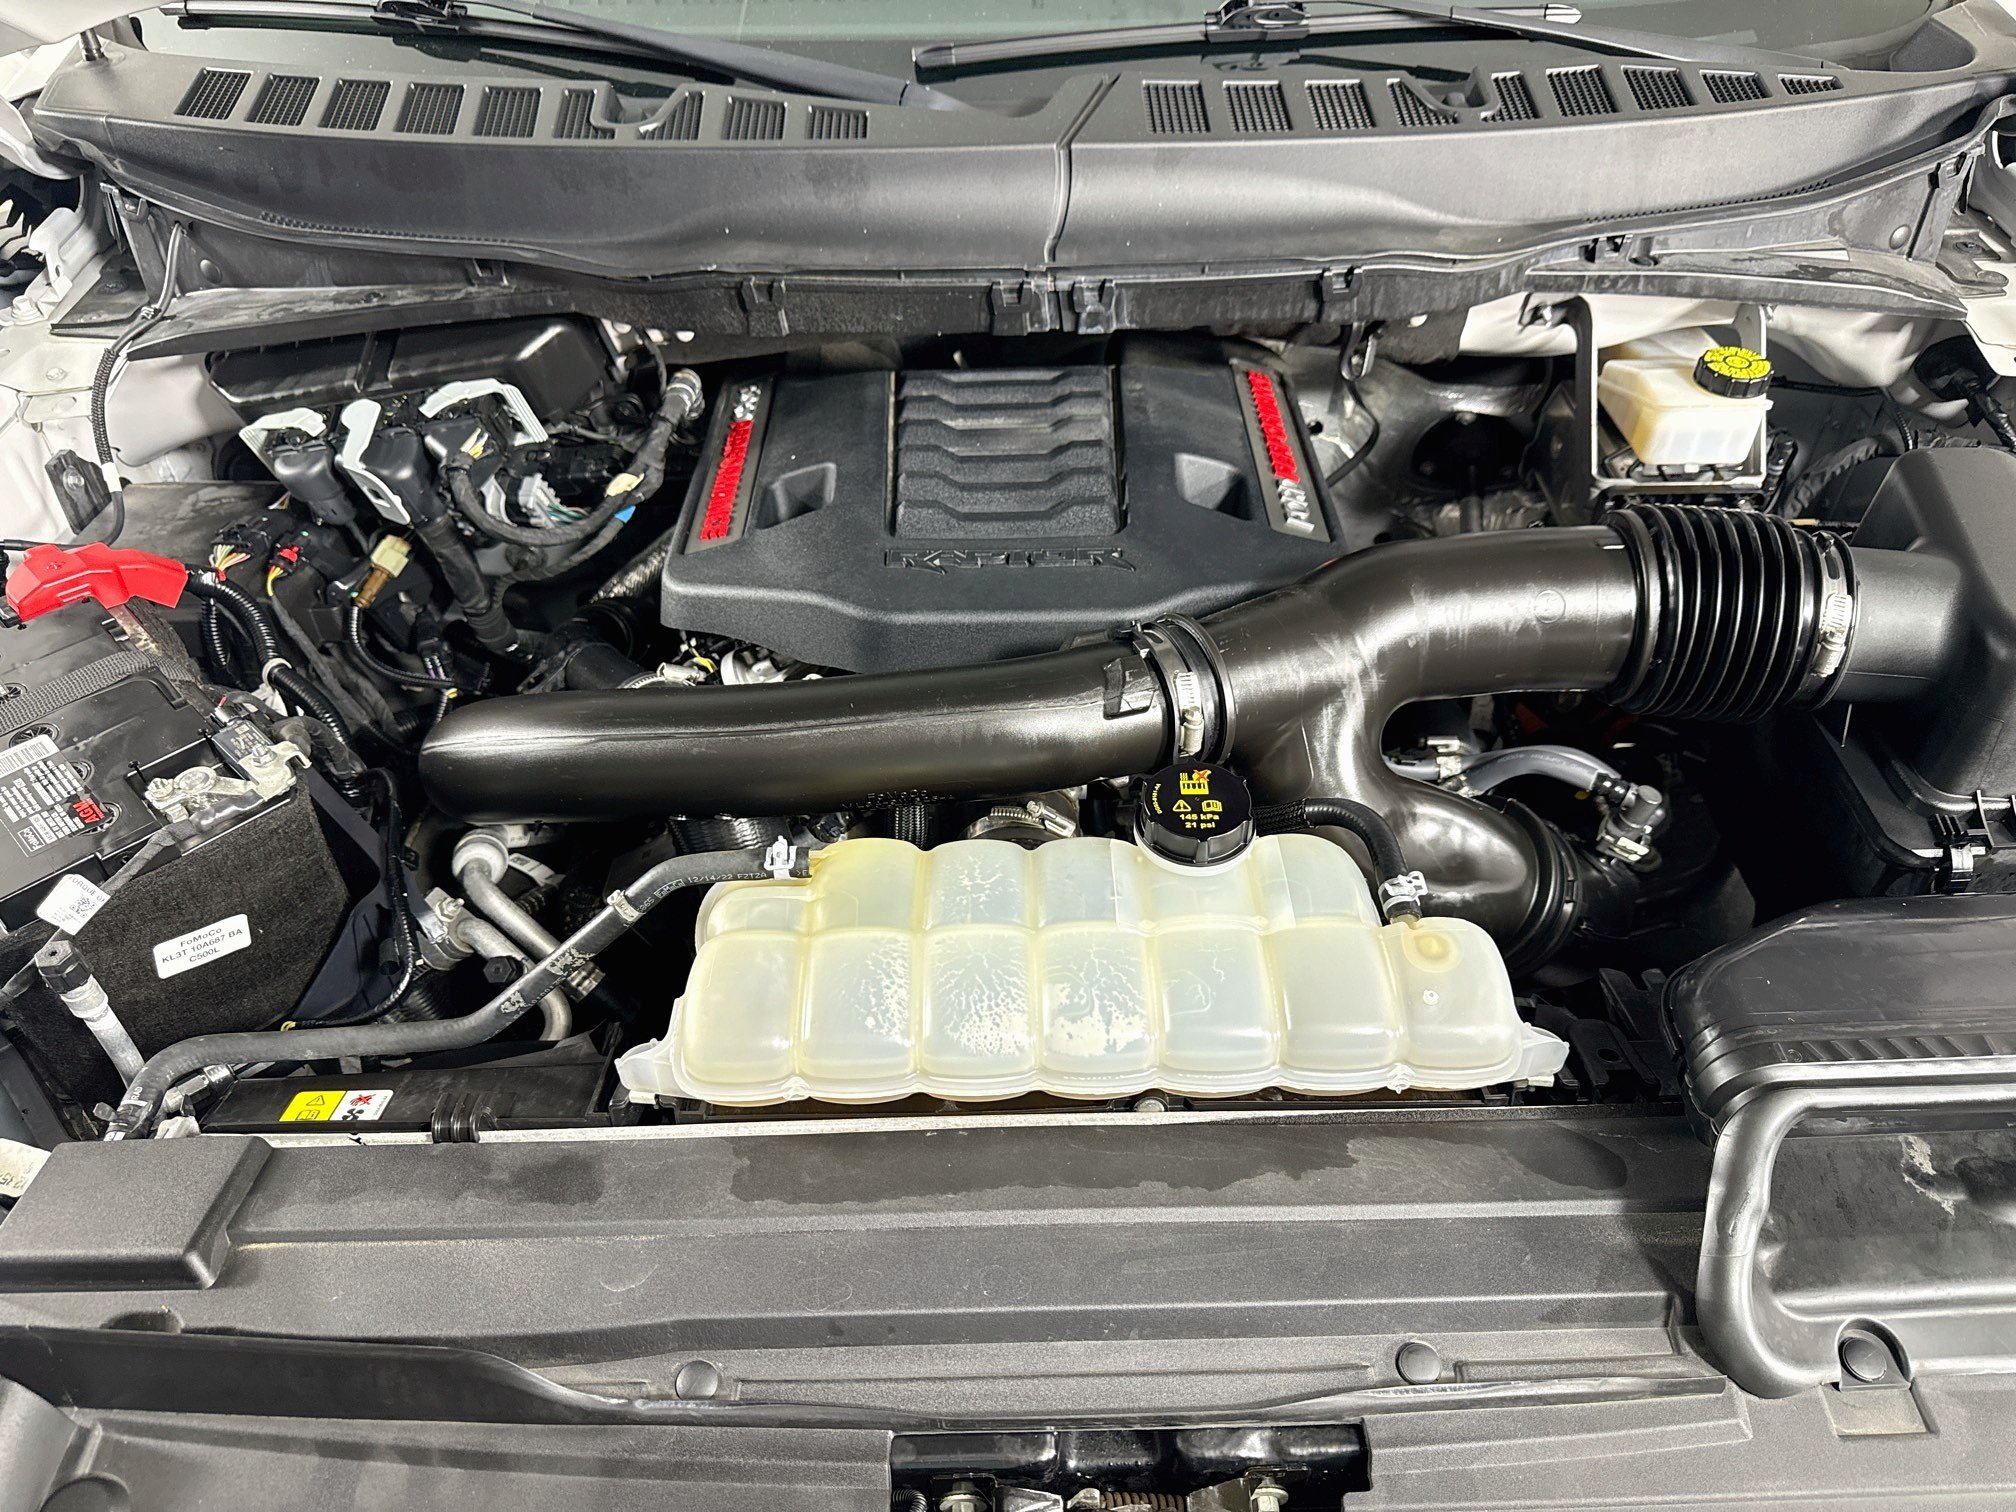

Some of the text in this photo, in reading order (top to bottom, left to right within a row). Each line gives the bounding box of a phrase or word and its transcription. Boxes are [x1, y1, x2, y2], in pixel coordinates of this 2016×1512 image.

[884, 547, 1136, 575] RAPTOR
[72, 799, 100, 824] AGM
[1184, 821, 1215, 830] 21 psi
[688, 873, 734, 883] 12/14/22
[162, 928, 243, 964] KL3T 10A687 BA
[180, 928, 222, 947] FoMoCo
[189, 947, 220, 963] C500L
